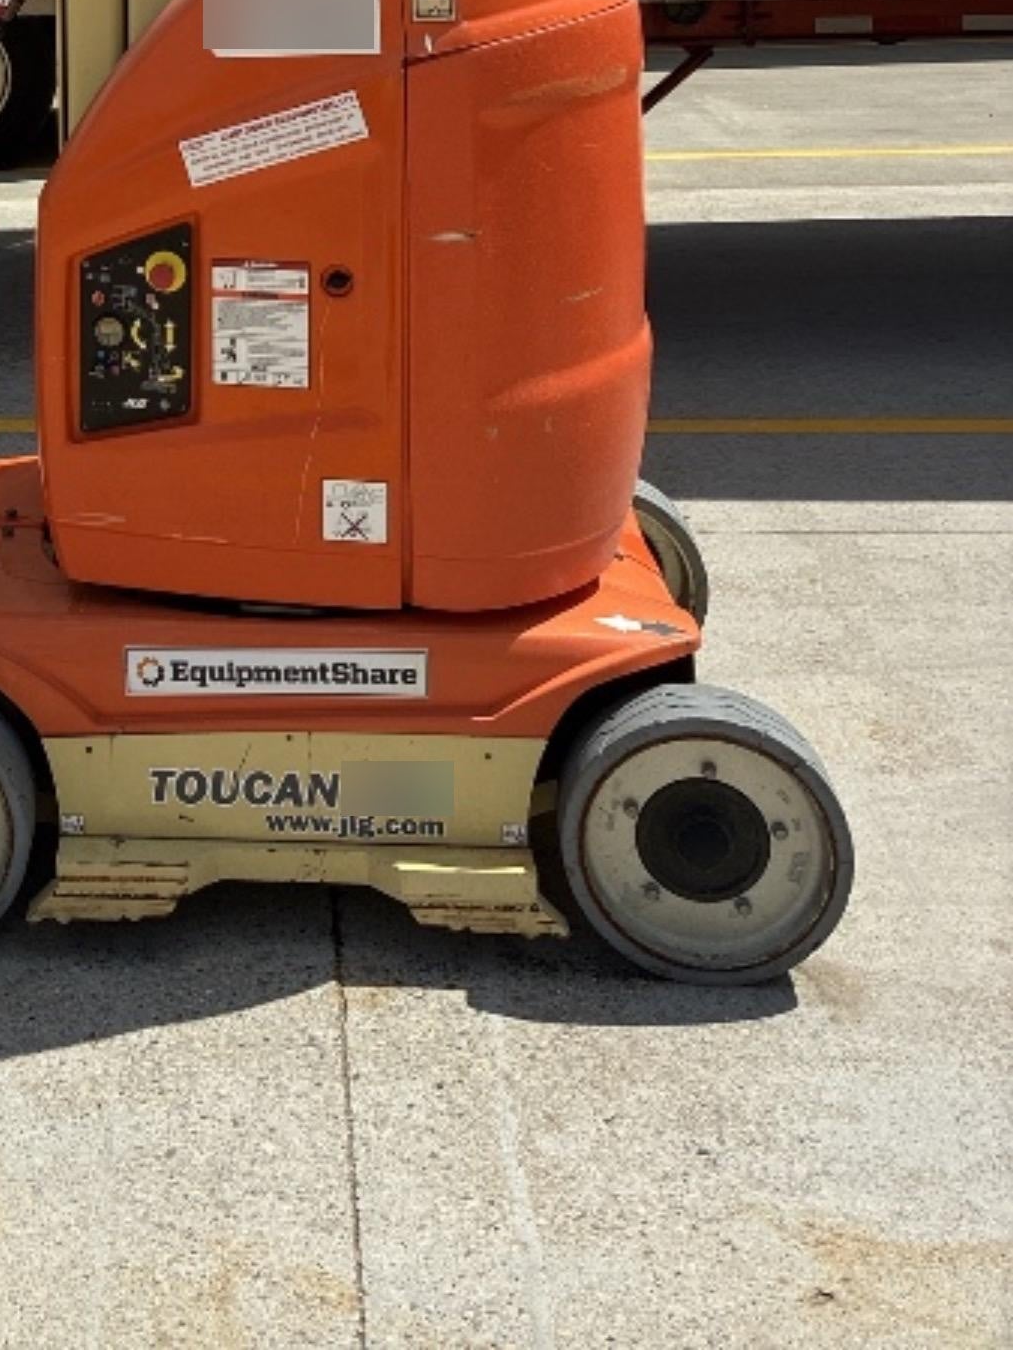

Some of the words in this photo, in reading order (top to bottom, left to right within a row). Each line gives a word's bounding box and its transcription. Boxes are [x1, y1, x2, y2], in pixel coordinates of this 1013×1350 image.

[169, 659, 418, 687] EquipmentShare
[149, 769, 339, 808] TOUCAN
[266, 814, 445, 837] www.jlg.com
